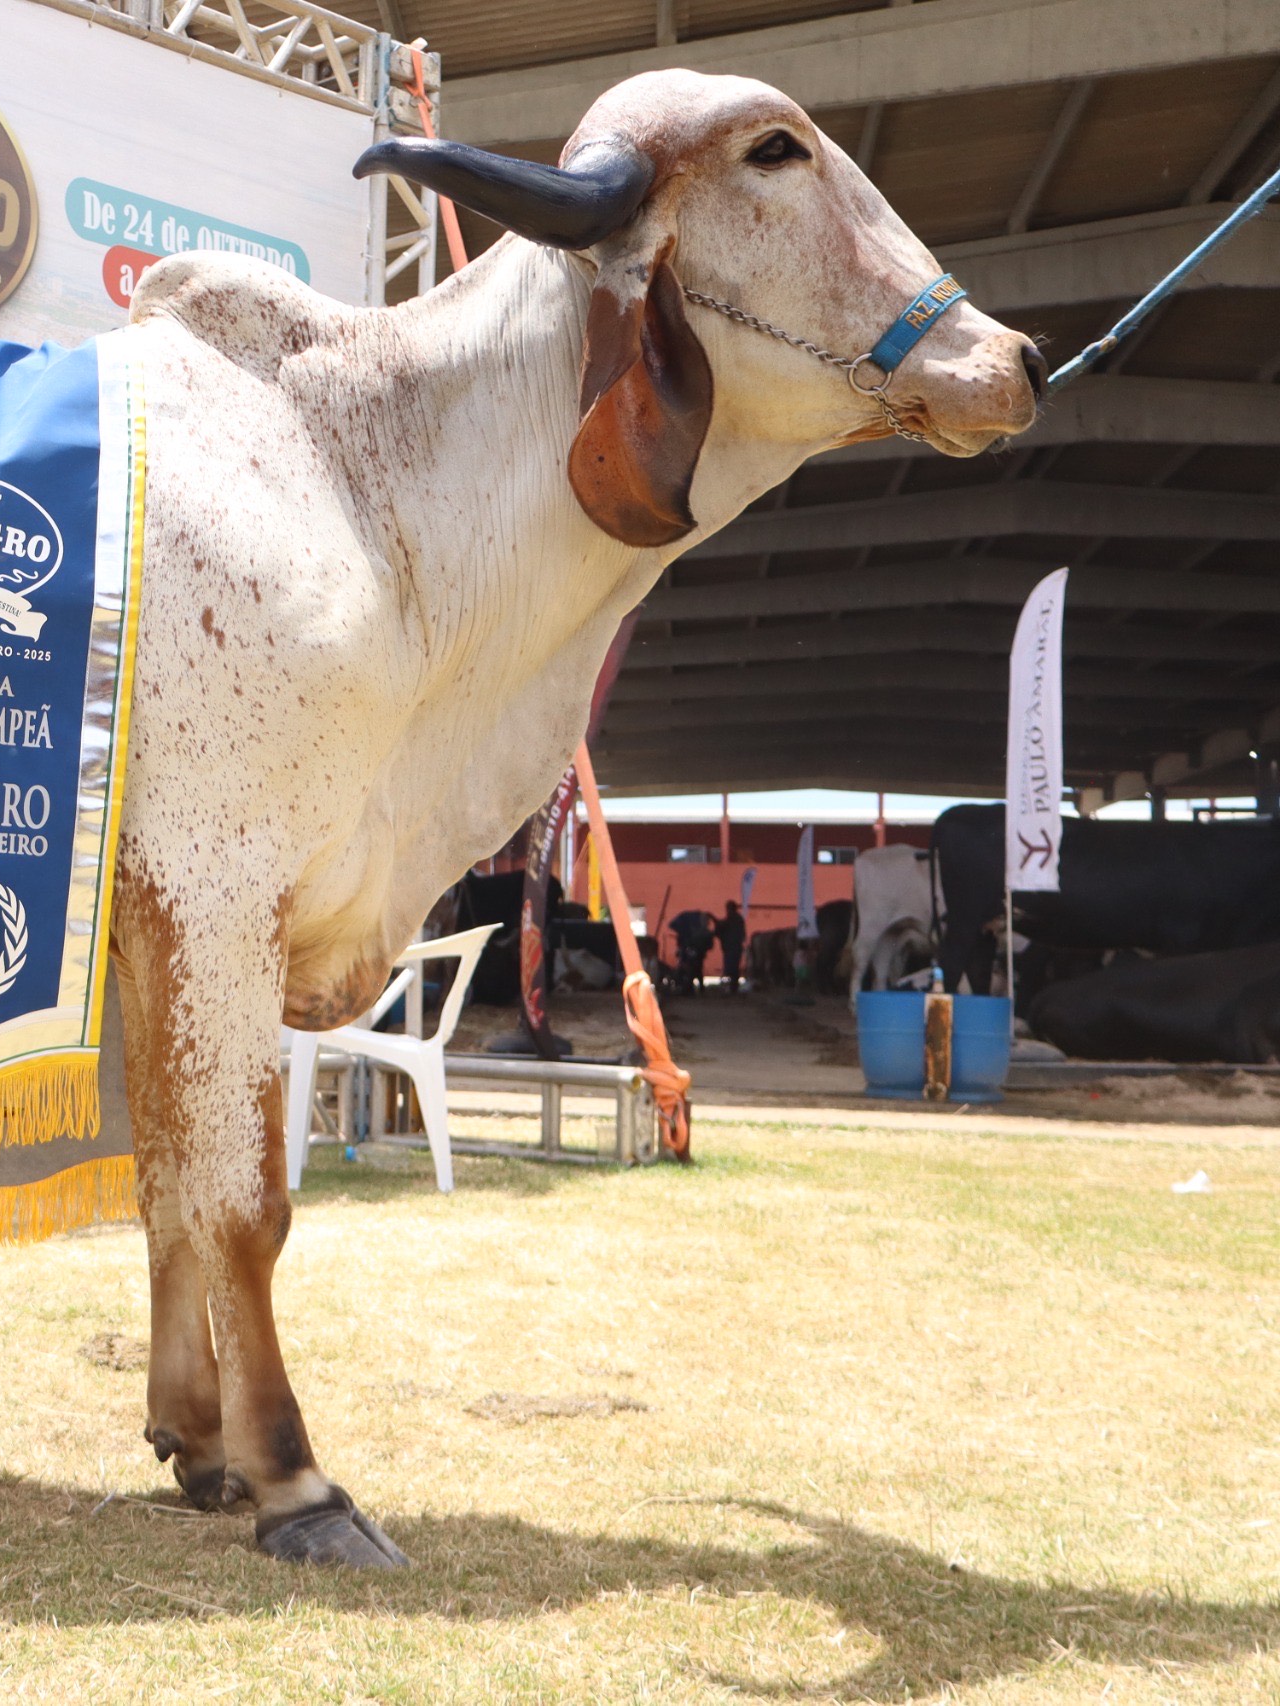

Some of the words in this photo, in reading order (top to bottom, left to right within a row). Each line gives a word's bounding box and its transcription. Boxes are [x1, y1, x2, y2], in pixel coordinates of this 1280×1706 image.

[82, 190, 116, 235] De
[123, 203, 154, 247] 24
[161, 216, 190, 253] de
[24, 648, 52, 662] 2025
[1031, 726, 1050, 813] PAULO
